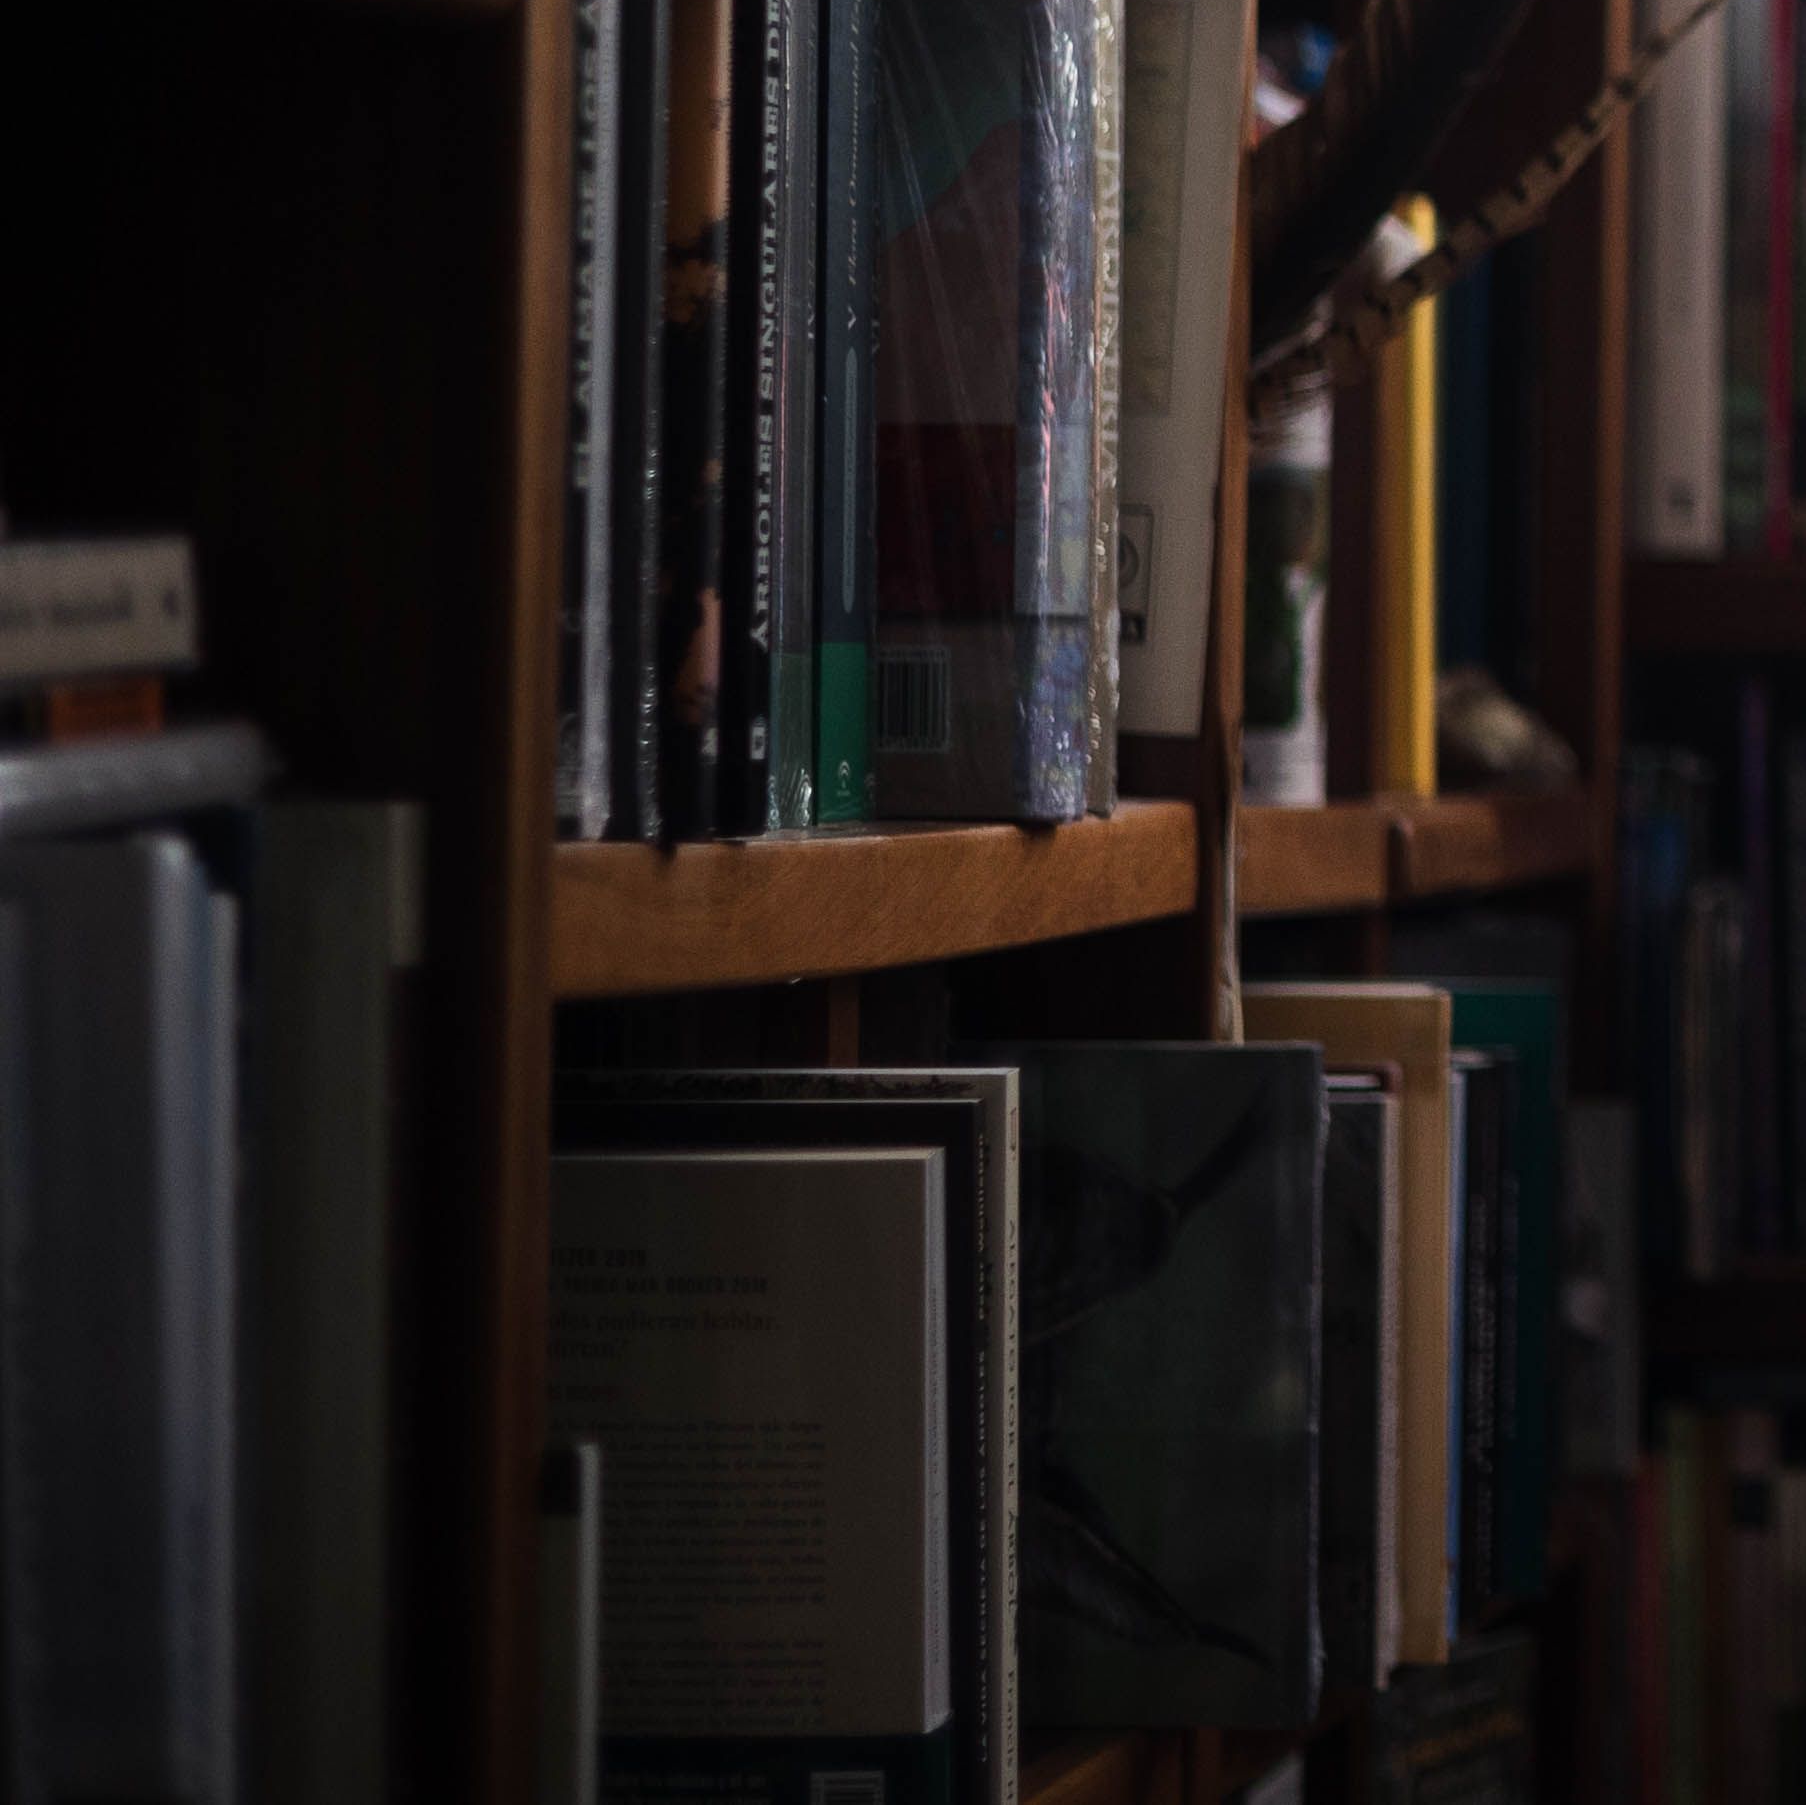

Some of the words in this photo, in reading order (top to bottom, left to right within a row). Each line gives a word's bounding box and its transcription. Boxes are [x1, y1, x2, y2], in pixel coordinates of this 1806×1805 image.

[757, 75, 778, 401] SINGULARES
[848, 41, 859, 208] Ornamental
[749, 414, 773, 652] ÁRBOLES
